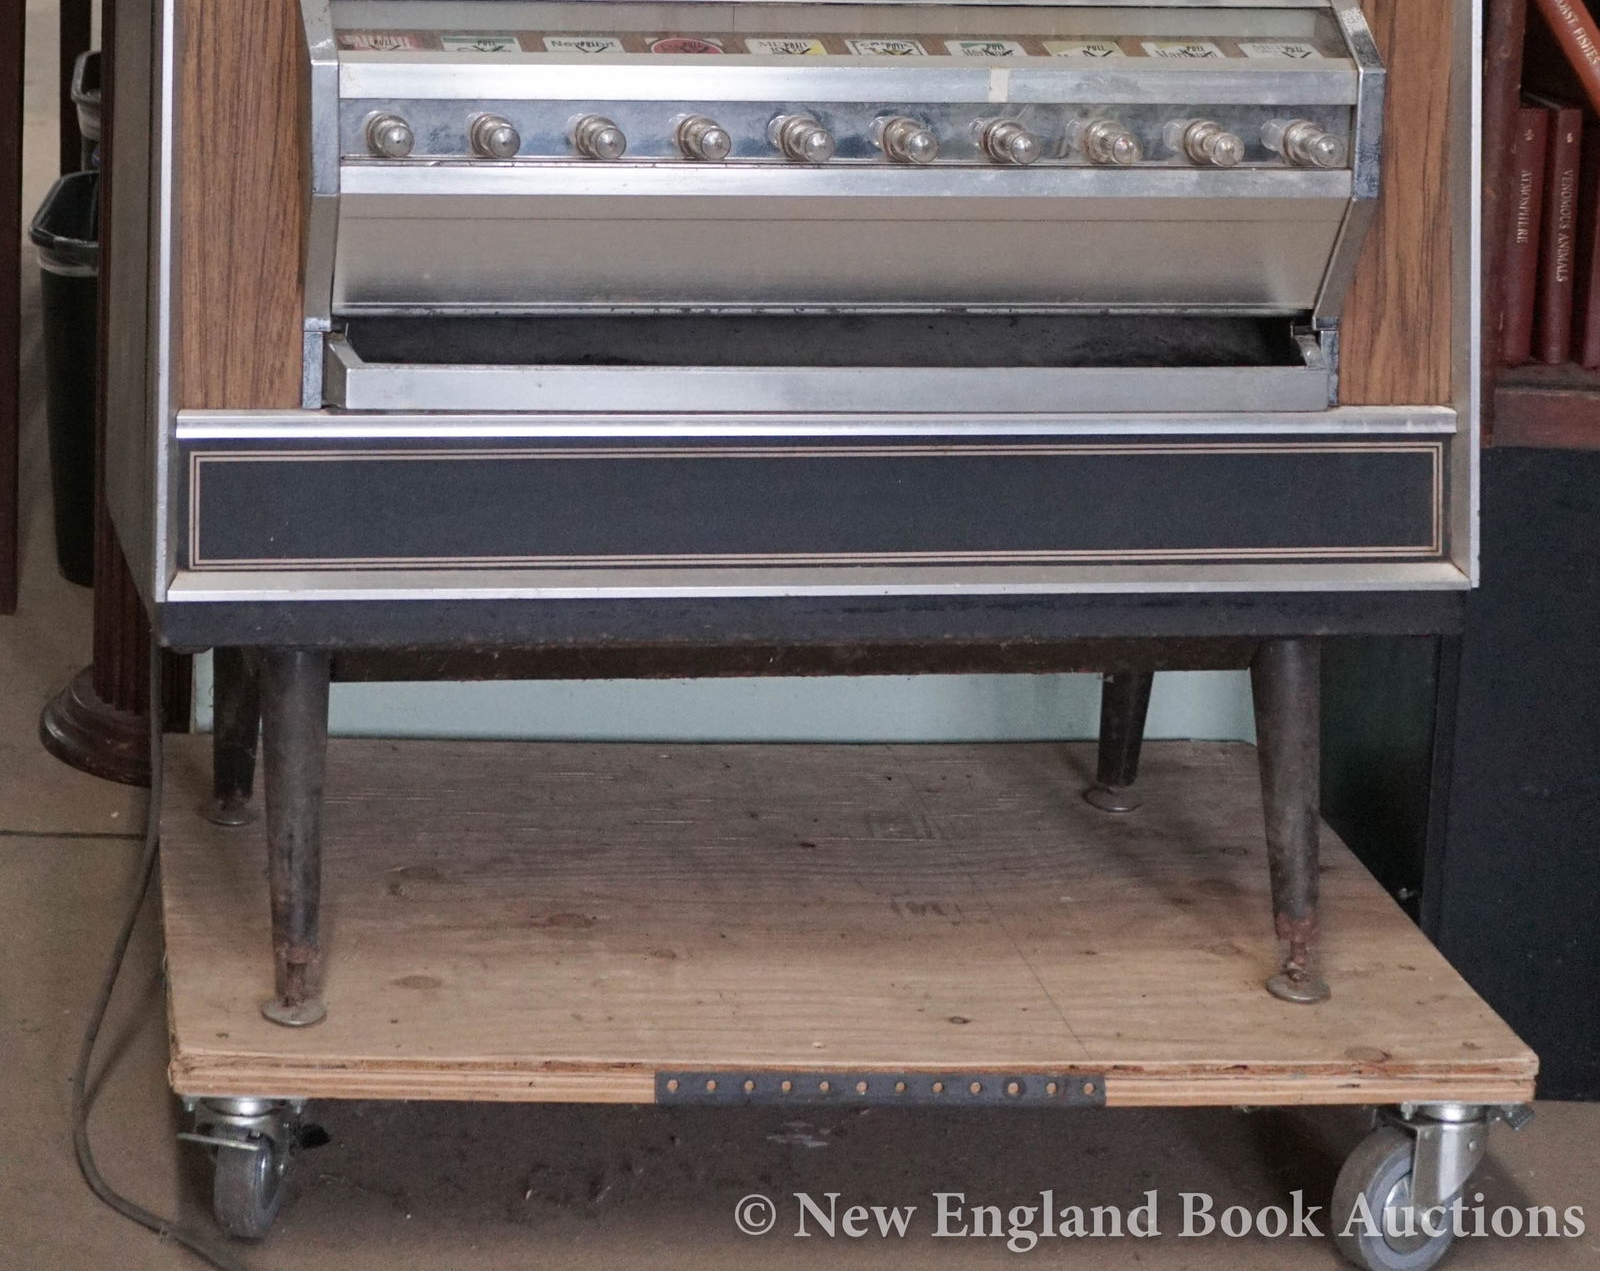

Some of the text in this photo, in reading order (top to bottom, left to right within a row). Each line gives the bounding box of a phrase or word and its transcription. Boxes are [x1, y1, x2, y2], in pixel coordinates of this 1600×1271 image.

[1573, 26, 1600, 66] FISHES
[1516, 170, 1533, 244] ATMOSPHERE
[1556, 169, 1574, 282] VENOMOUS ANIMALS
